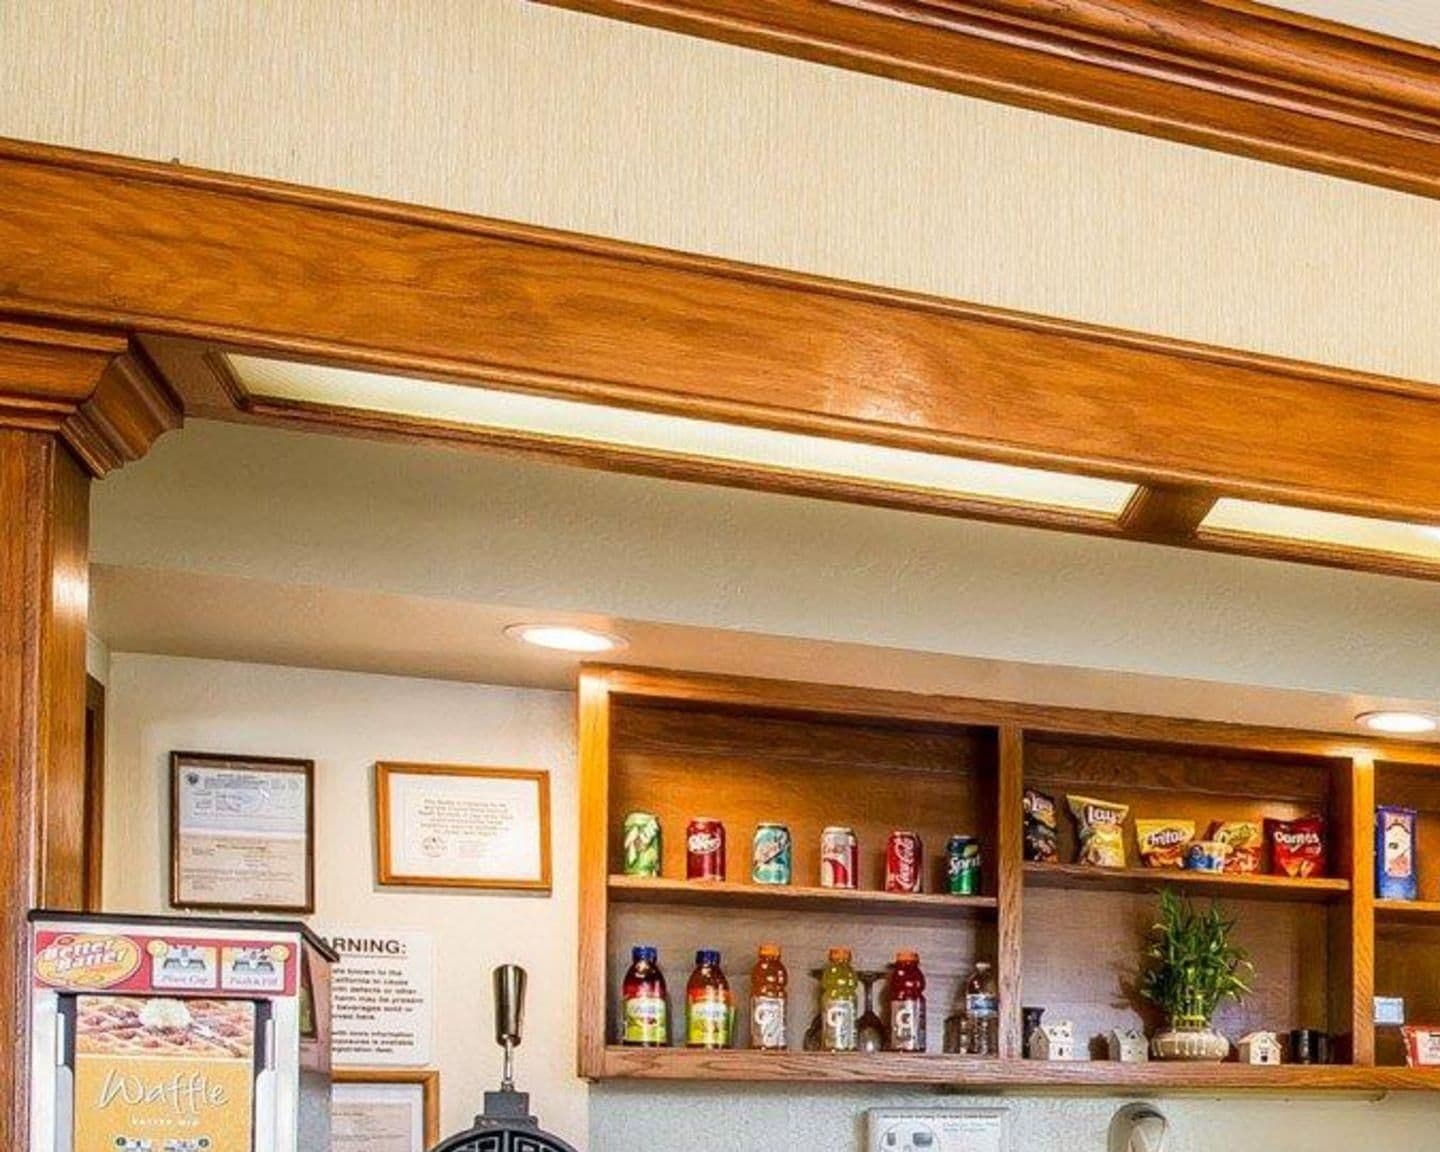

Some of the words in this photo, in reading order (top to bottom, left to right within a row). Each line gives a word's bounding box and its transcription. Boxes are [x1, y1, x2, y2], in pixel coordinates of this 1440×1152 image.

[949, 854, 981, 876] Sprit
[320, 936, 407, 954] RNING:
[96, 1068, 229, 1114] Waffle
